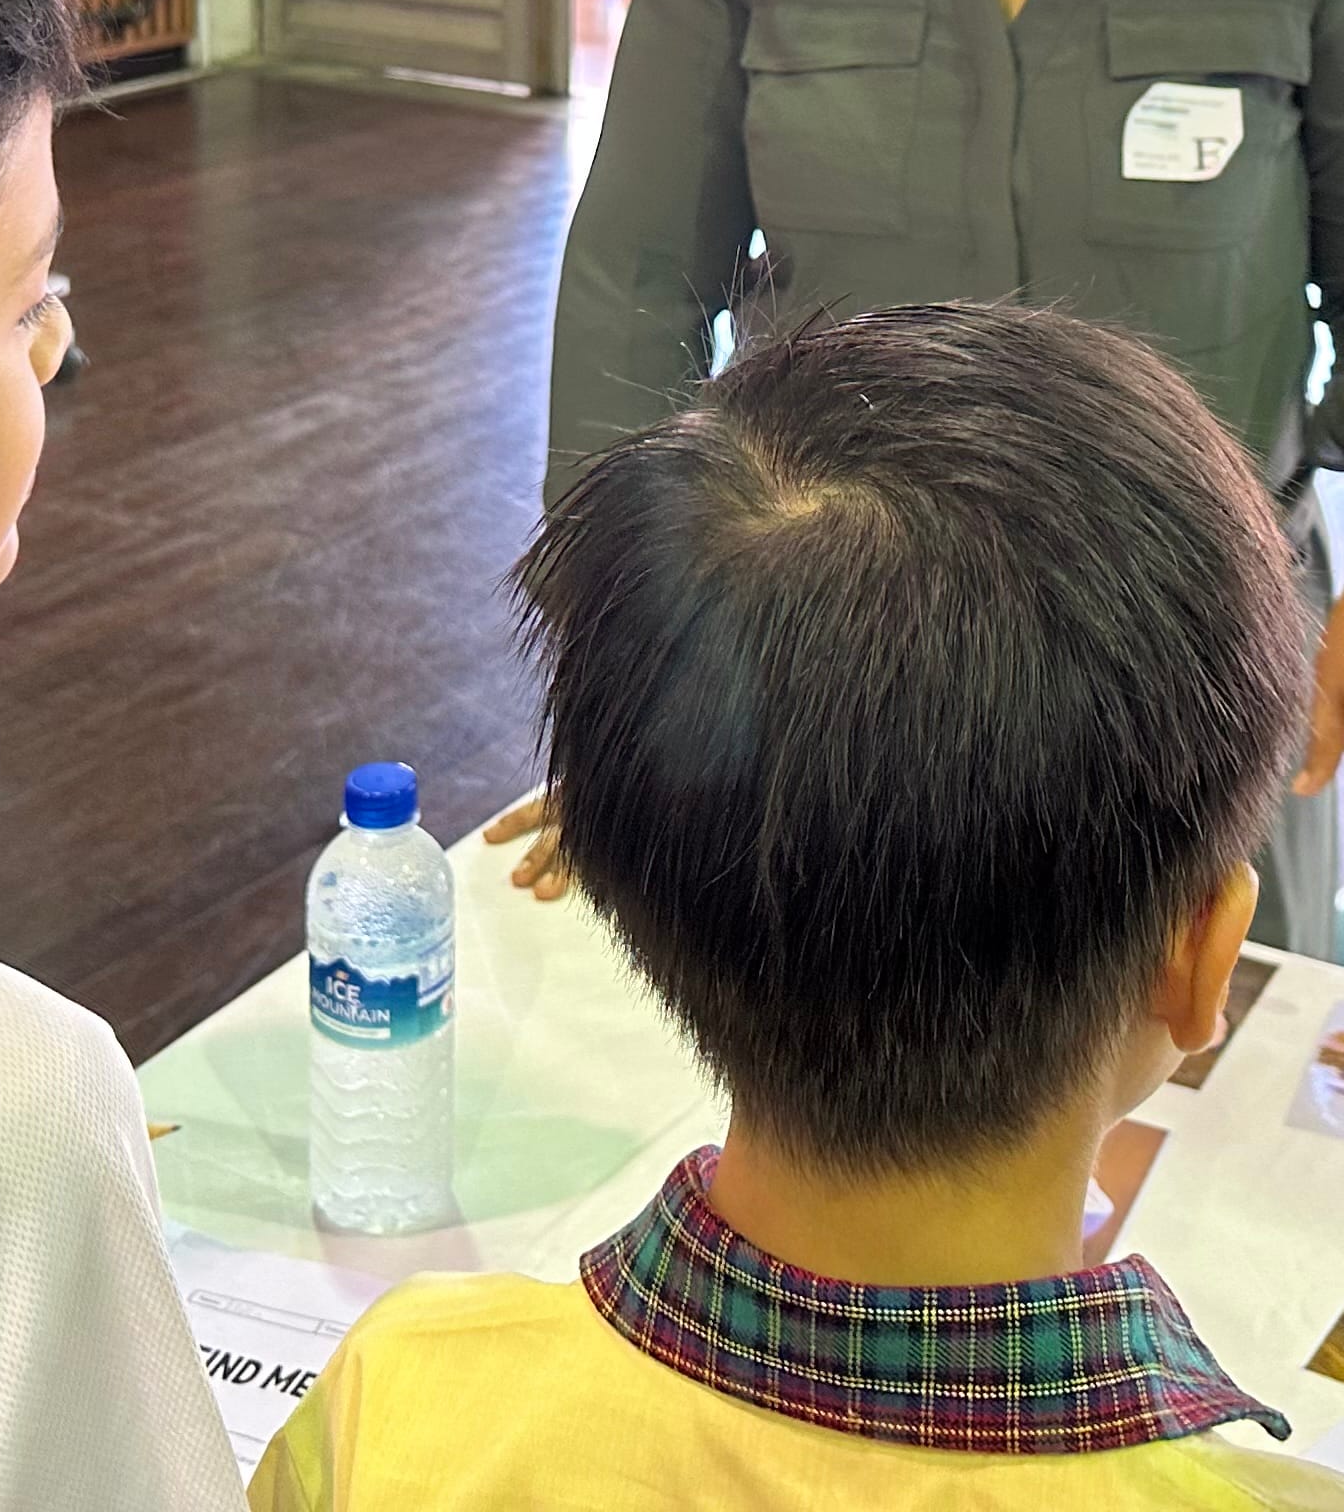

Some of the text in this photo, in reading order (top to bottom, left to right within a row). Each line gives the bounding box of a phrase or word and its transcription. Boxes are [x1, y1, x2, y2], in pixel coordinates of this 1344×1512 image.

[311, 985, 391, 1024] MOUNTAIN
[325, 975, 361, 1004] ICE
[259, 1363, 318, 1398] ME
